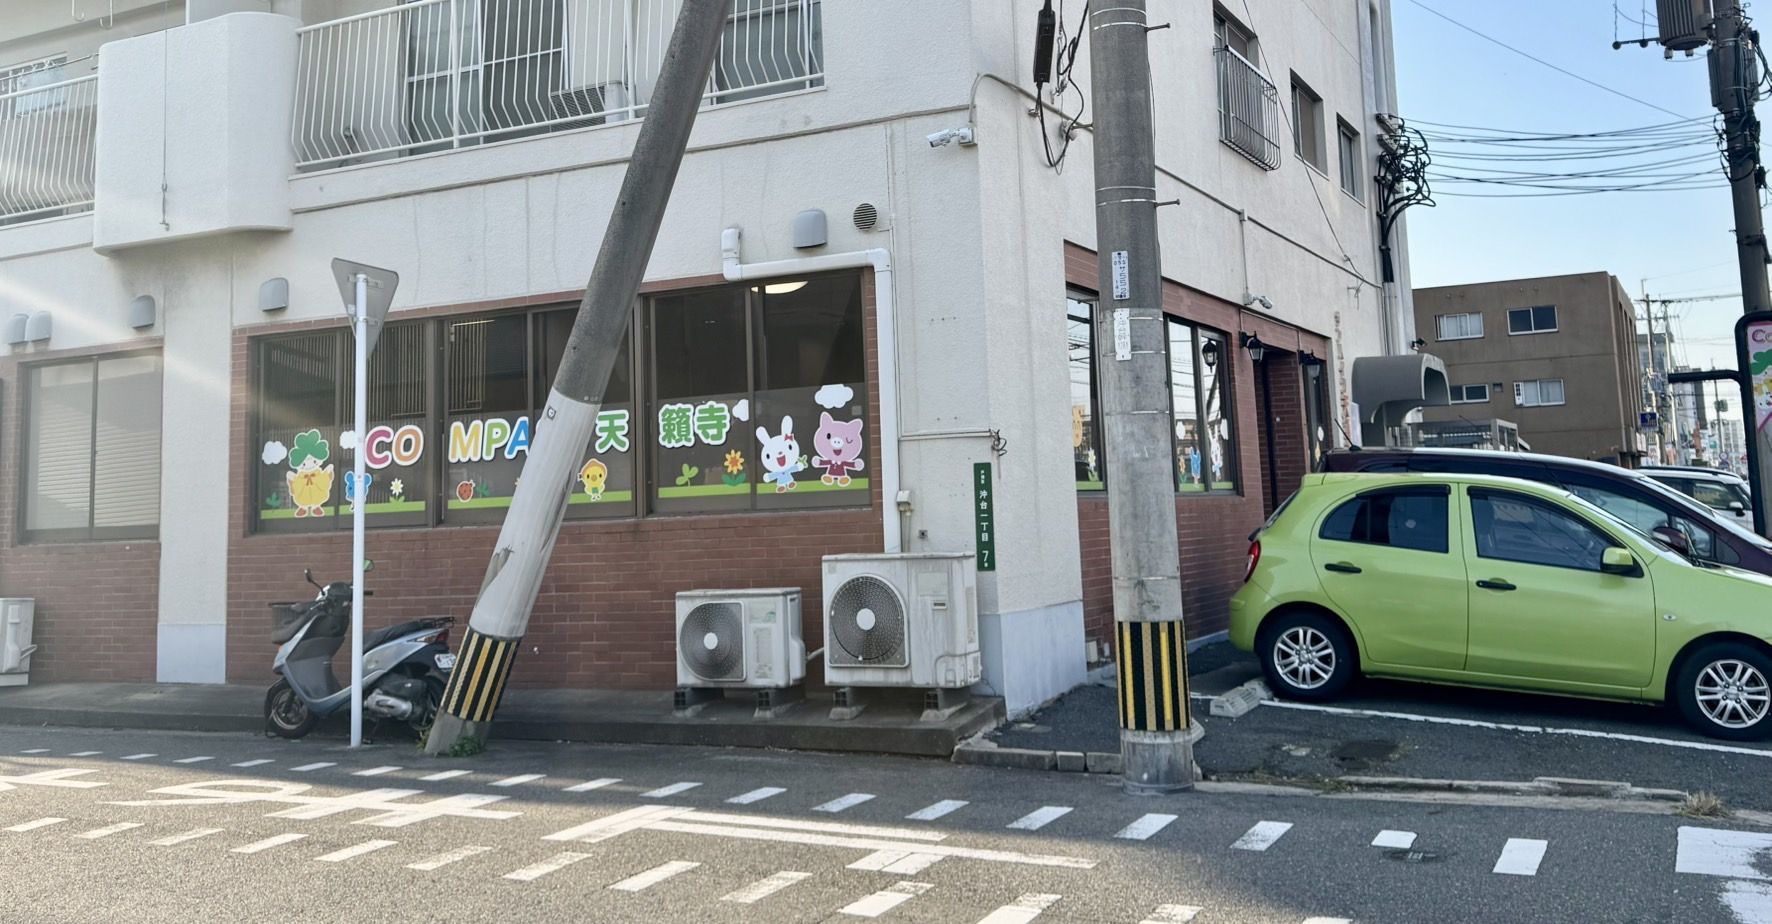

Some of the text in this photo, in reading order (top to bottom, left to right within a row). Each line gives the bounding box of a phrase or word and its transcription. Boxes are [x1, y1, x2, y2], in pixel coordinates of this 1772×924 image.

[366, 426, 423, 467] CO
[597, 410, 629, 452] 天
[979, 490, 989, 541] 沖台一丁目
